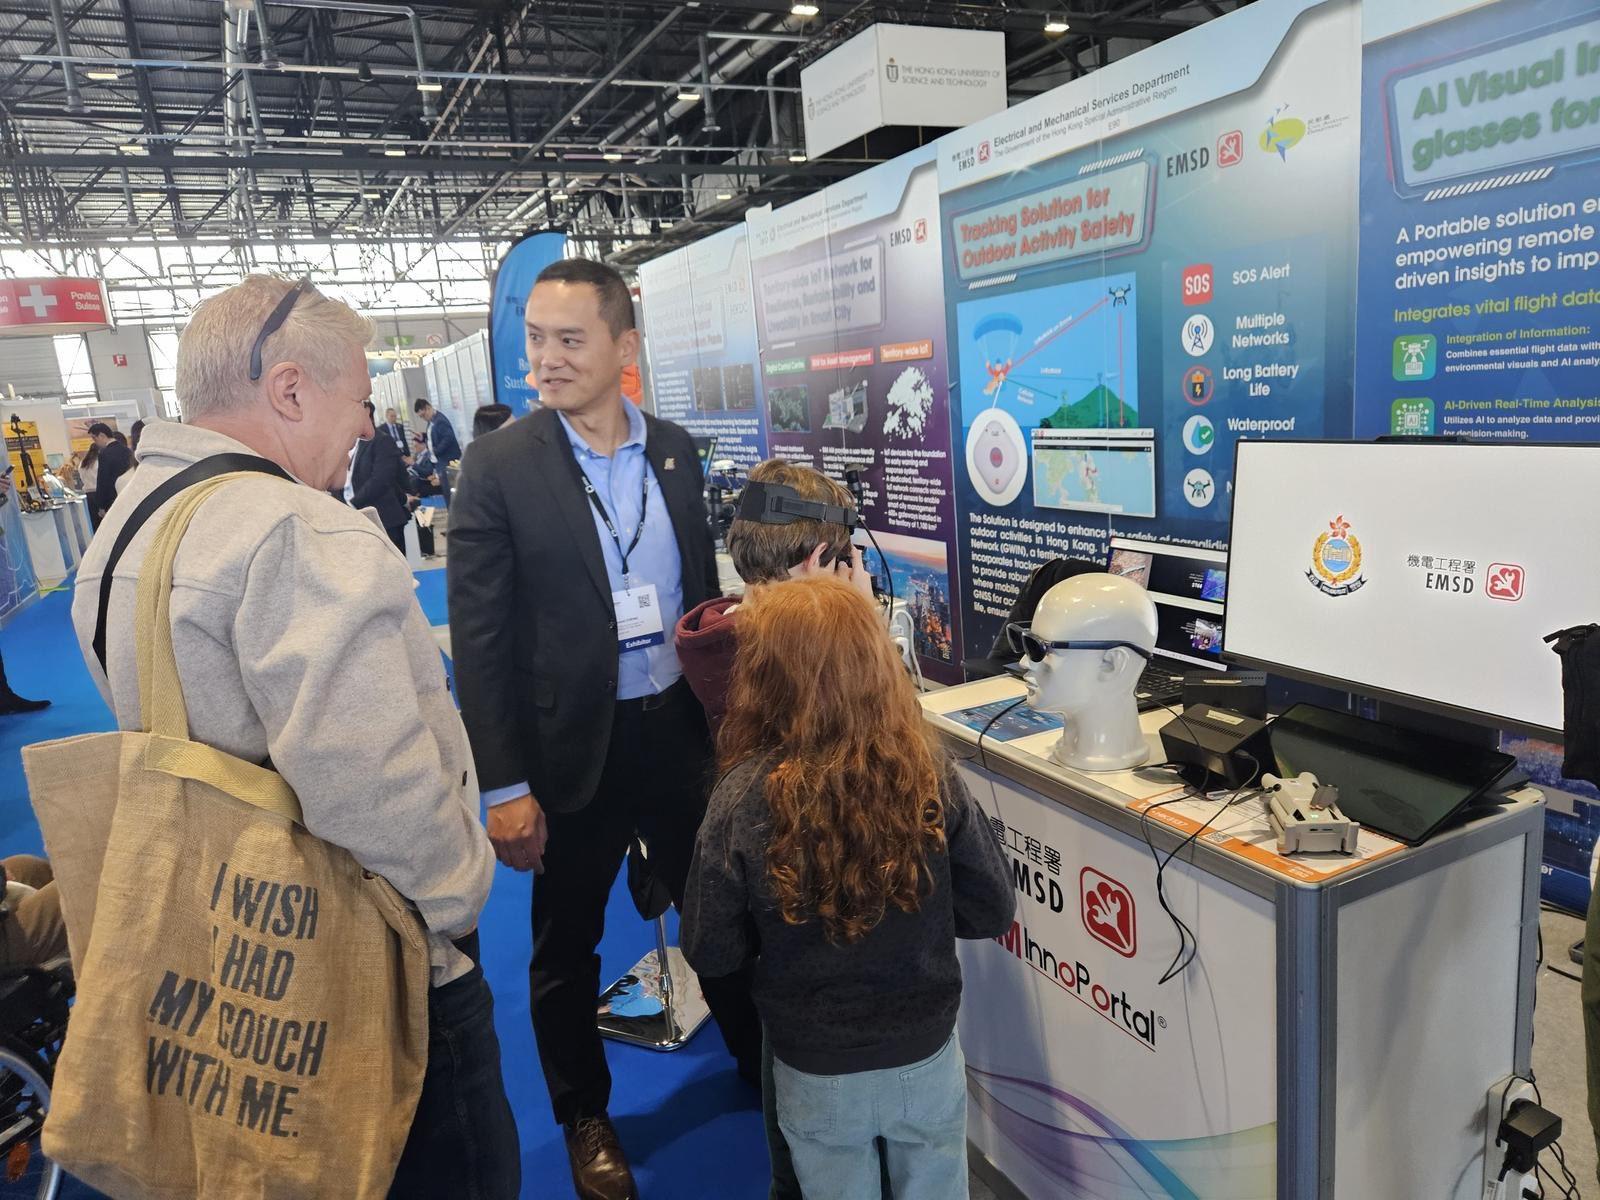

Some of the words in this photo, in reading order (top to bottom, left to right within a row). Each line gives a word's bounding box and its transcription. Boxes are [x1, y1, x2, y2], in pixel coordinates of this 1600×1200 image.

[902, 66, 914, 74] THE
[915, 66, 934, 76] HONG
[935, 68, 956, 76] KONG
[956, 68, 991, 78] UNIVERSITY
[992, 70, 1000, 78] OF
[902, 76, 926, 84] SCIENCE
[946, 78, 988, 87] TECHNOLOGY
[1413, 82, 1447, 120] AI
[1455, 48, 1564, 107] Visual
[994, 130, 1026, 148] Electrical
[1028, 122, 1042, 134] and
[1044, 102, 1089, 129] Mechanical
[1092, 89, 1130, 110] Services
[1132, 64, 1190, 96] Department
[1004, 140, 1034, 156] Government
[1052, 128, 1065, 140] Hong
[1068, 122, 1083, 136] Kong
[1084, 111, 1106, 130] Special
[1106, 96, 1152, 119] Administrative
[1152, 85, 1177, 102] Region
[1412, 112, 1540, 171] glasses
[958, 158, 975, 172] EMSD
[1166, 147, 1210, 178] EMSD
[960, 212, 1018, 242] Tracking
[1020, 194, 1082, 226] Solution
[1086, 188, 1110, 210] for
[1396, 228, 1409, 244] A
[1415, 215, 1490, 241] Portable
[1496, 201, 1575, 228] solution
[890, 228, 912, 247] EMSD
[962, 241, 1016, 268] Outdoor
[1020, 225, 1076, 257] Activity
[1080, 212, 1136, 242] Safety
[1396, 237, 1512, 267] empowering
[1518, 223, 1595, 249] remote
[859, 255, 872, 272] for
[1395, 269, 1449, 290] driven
[1455, 259, 1525, 282] insights
[1531, 255, 1551, 272] to
[1233, 271, 1257, 284] SOS
[1260, 264, 1290, 281] Alert
[856, 276, 876, 294] and
[1185, 273, 1210, 295] SOS
[75, 302, 100, 311] Suisse
[834, 303, 852, 323] City
[1394, 304, 1470, 323] Integrates
[1475, 297, 1509, 313] vital
[1514, 292, 1557, 313] flight
[1236, 312, 1285, 330] Multiple
[1232, 331, 1289, 348] Networks
[1447, 332, 1502, 345] Integration
[1506, 330, 1517, 339] of
[1519, 325, 1590, 338] Information:
[1446, 349, 1488, 359] Combines
[1489, 347, 1529, 357] essential
[1531, 344, 1555, 354] flight
[1557, 343, 1578, 352] data
[1581, 341, 1600, 351] with
[1223, 367, 1251, 381] Long
[1255, 363, 1299, 379] Battery
[1445, 362, 1505, 372] environmental
[1507, 360, 1538, 369] visuals
[1541, 358, 1558, 367] and
[1561, 358, 1571, 366] AI
[1250, 382, 1270, 396] Life
[1444, 400, 1492, 410] AI-Driven
[1495, 398, 1549, 409] Real-Time
[1228, 417, 1295, 433] Waterproof
[1444, 416, 1474, 424] Utilizes
[1476, 416, 1485, 424] AI
[1487, 416, 1495, 424] to
[1497, 416, 1531, 425] analyze
[1533, 415, 1552, 424] data
[1554, 415, 1572, 424] and
[1457, 429, 1528, 439] decision-making.
[969, 513, 981, 523] The
[983, 514, 1010, 527] Solution
[1012, 517, 1018, 527] is
[1019, 518, 1055, 533] designed
[1057, 523, 1066, 533] to
[1068, 525, 1106, 538] enhance
[970, 528, 997, 538] outdoor
[1000, 532, 1032, 543] activities
[1036, 535, 1043, 544] in
[1047, 536, 1068, 549] Hong
[1072, 540, 1097, 553] Kong.
[971, 539, 999, 552] Network
[1000, 544, 1028, 557] (GWIN),
[971, 552, 1013, 567] incorporates
[1407, 553, 1477, 575] 機電工程署
[972, 565, 979, 574] to
[980, 566, 1007, 579] provide
[973, 578, 994, 589] where
[995, 584, 1020, 594] mobile
[1425, 573, 1474, 594] EMSD
[973, 590, 992, 601] GNSS
[992, 594, 1002, 604] for
[974, 602, 986, 614] life,
[625, 639, 651, 649] Exhibitor
[210, 862, 228, 911] I
[232, 873, 319, 940] WISH
[220, 934, 295, 1002] HAD
[1024, 927, 1155, 1046] InnoPortal
[146, 970, 215, 1037] MY
[217, 1002, 328, 1077] COUCH
[146, 1037, 231, 1117] WITH
[237, 1075, 299, 1138] ME.
